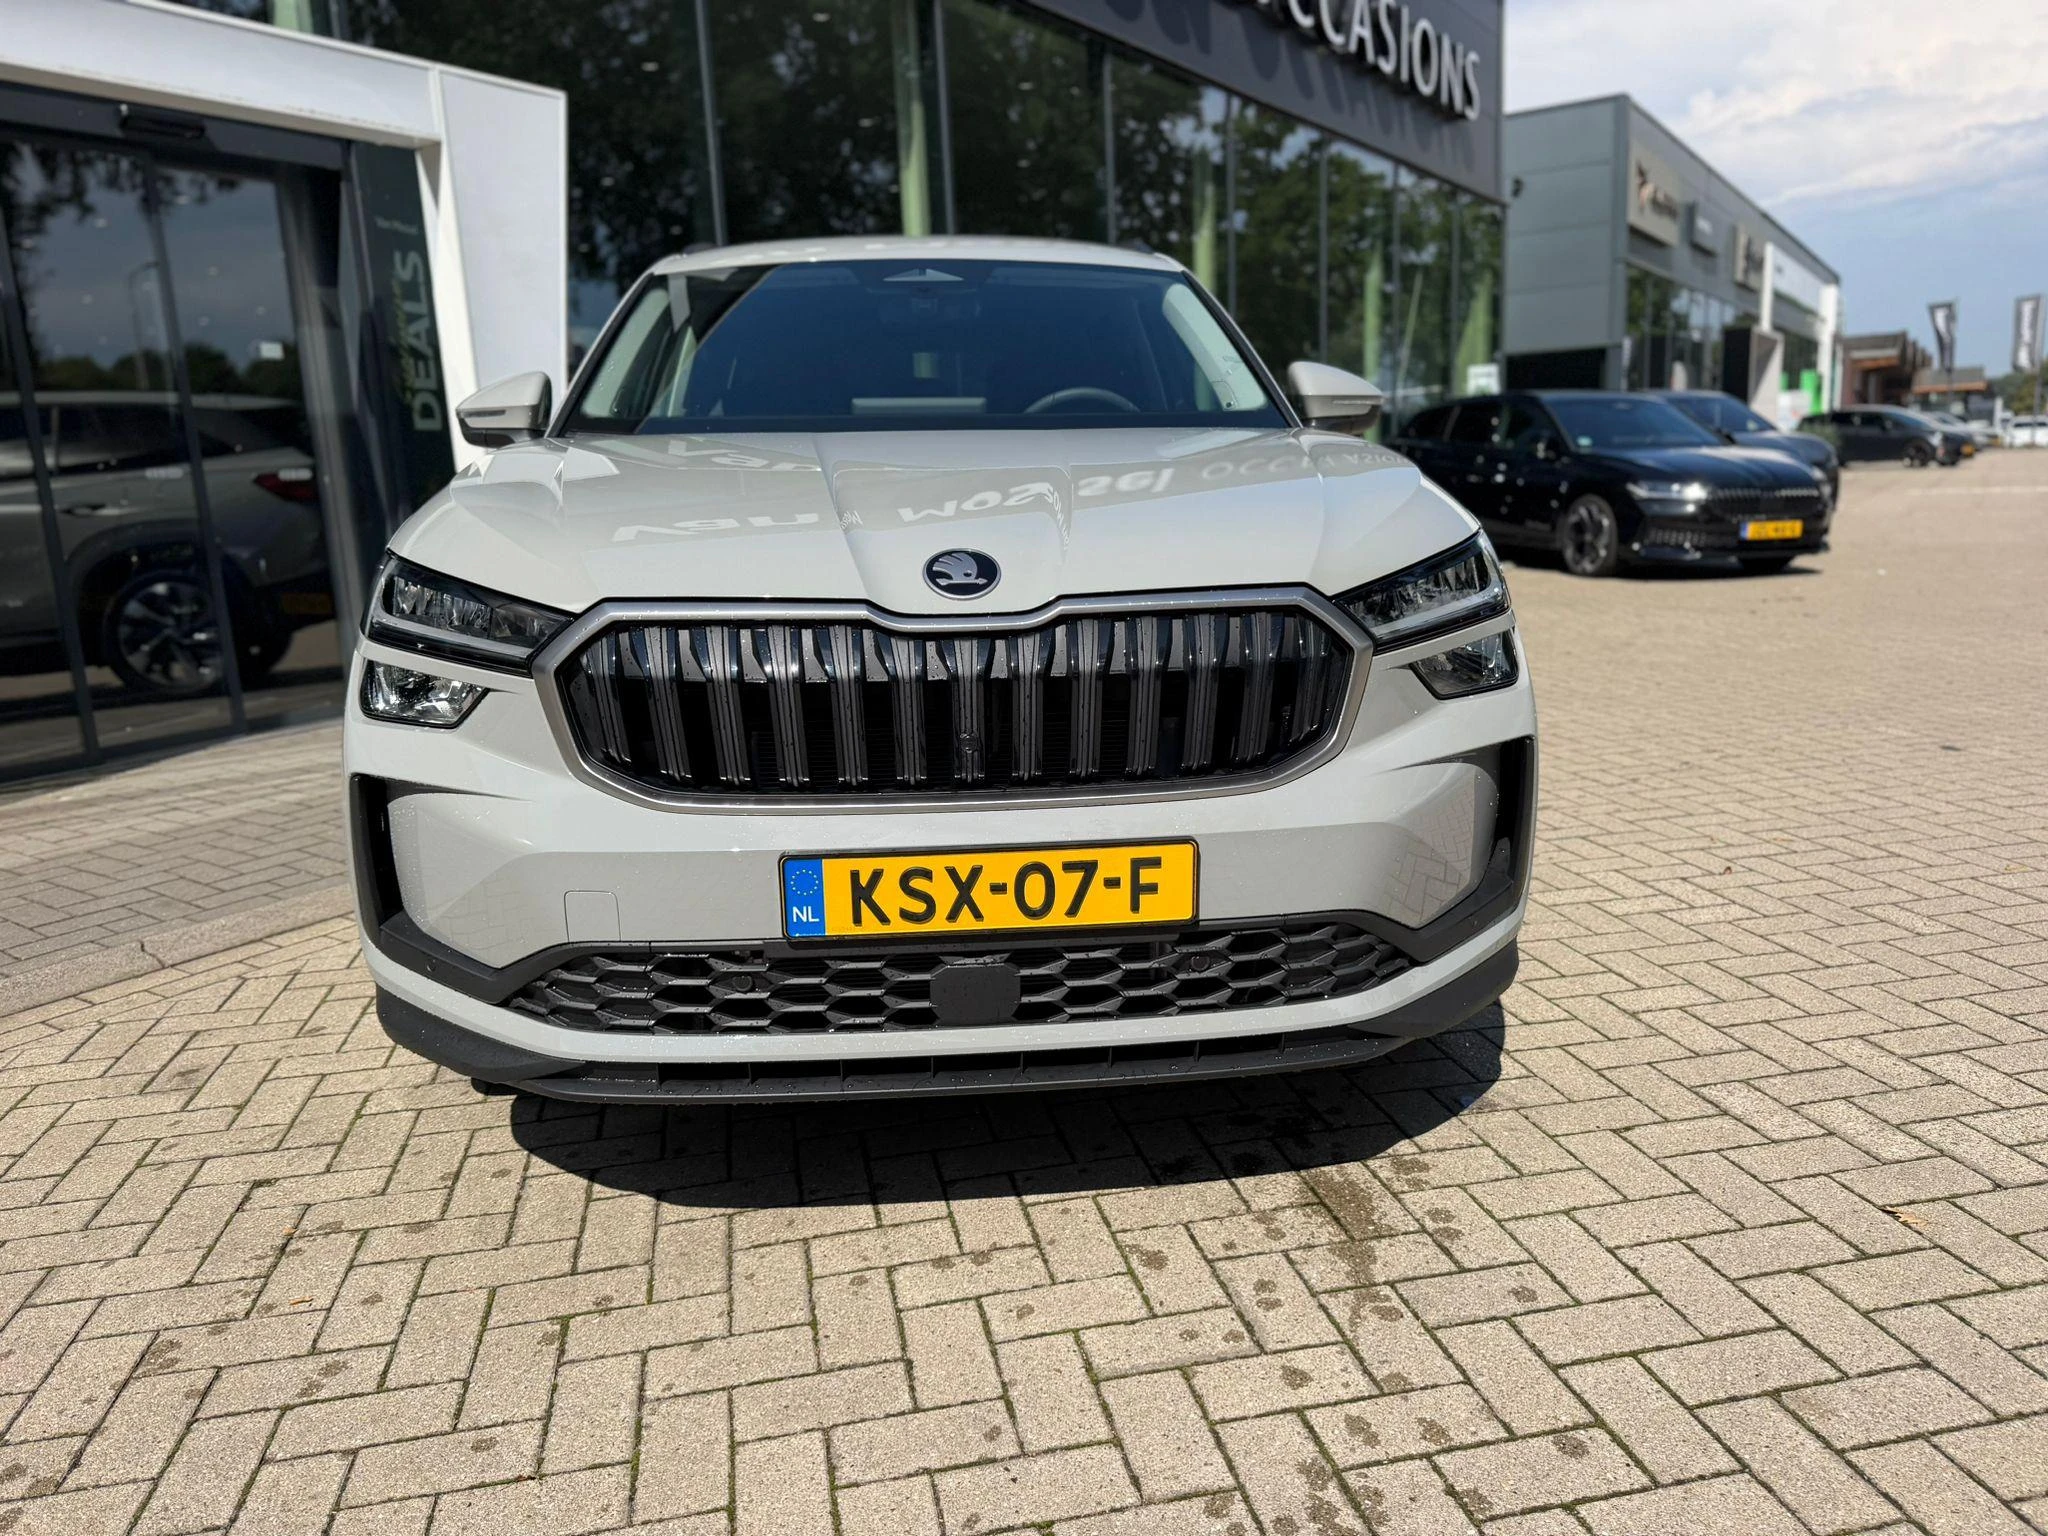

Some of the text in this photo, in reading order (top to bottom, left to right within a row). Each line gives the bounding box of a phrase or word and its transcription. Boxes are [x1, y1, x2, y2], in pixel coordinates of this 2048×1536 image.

[1253, 0, 1480, 121] CASIONS
[392, 250, 443, 431] DEALS
[792, 905, 820, 923] NL
[849, 856, 1162, 927] KSX-07-F
